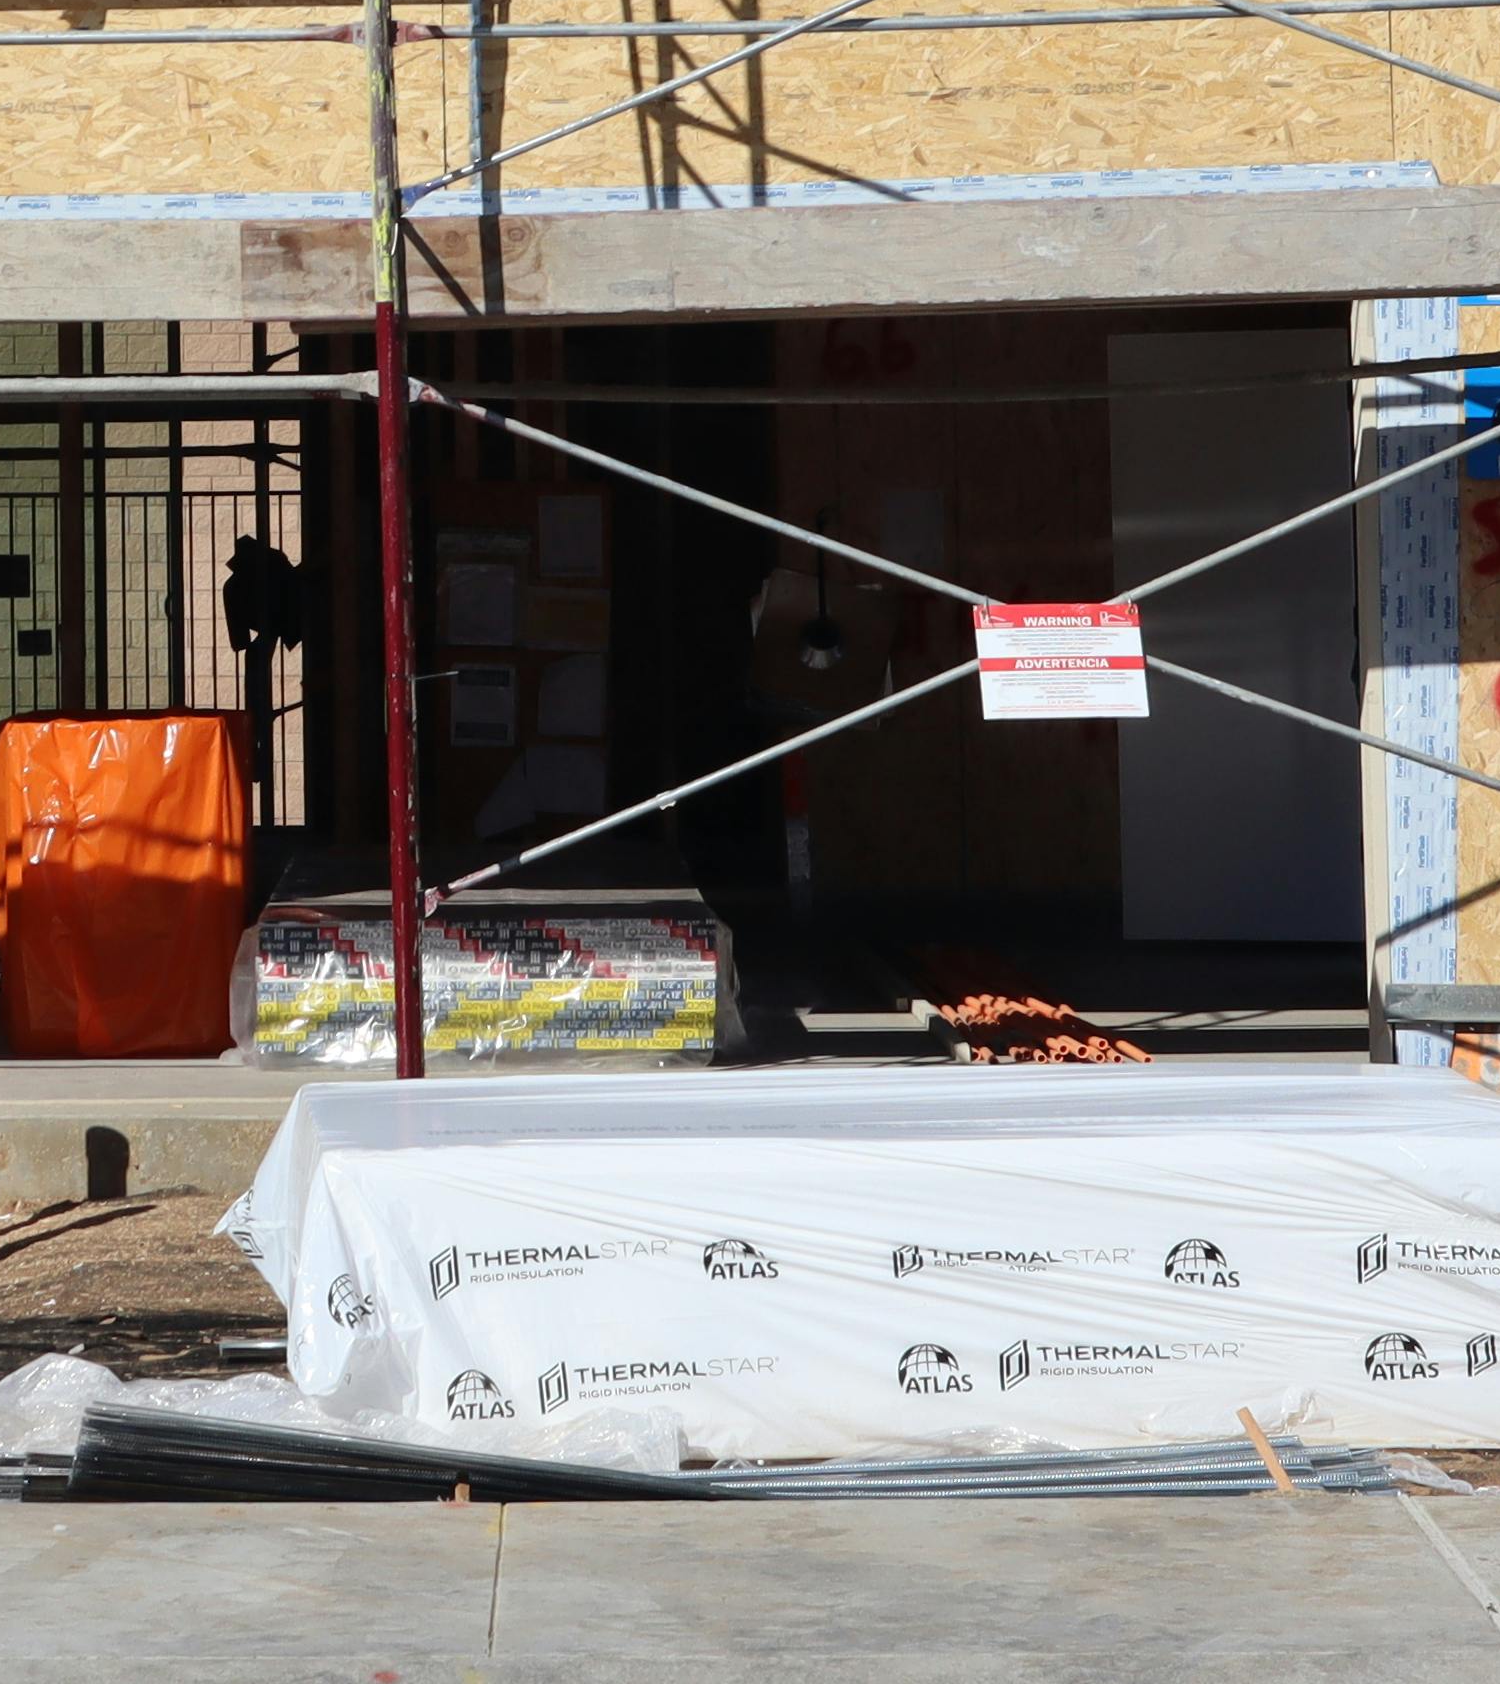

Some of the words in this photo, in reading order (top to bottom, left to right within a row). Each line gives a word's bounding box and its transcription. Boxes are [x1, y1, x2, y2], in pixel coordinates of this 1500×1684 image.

[1022, 616, 1093, 628] WARNING
[1014, 658, 1110, 670] ADVERTENCIA
[469, 1273, 505, 1284] RIGID
[506, 1267, 585, 1282] INSULATION
[710, 1261, 780, 1281] ATLAS
[1039, 1366, 1076, 1377] RIGID
[1077, 1365, 1154, 1376] INSULATION
[1371, 1362, 1440, 1382] ATLAS
[578, 1388, 613, 1399] RIGID
[614, 1381, 692, 1397] INSULATION
[905, 1374, 974, 1395] ATLAS
[450, 1400, 516, 1421] ATLAS
